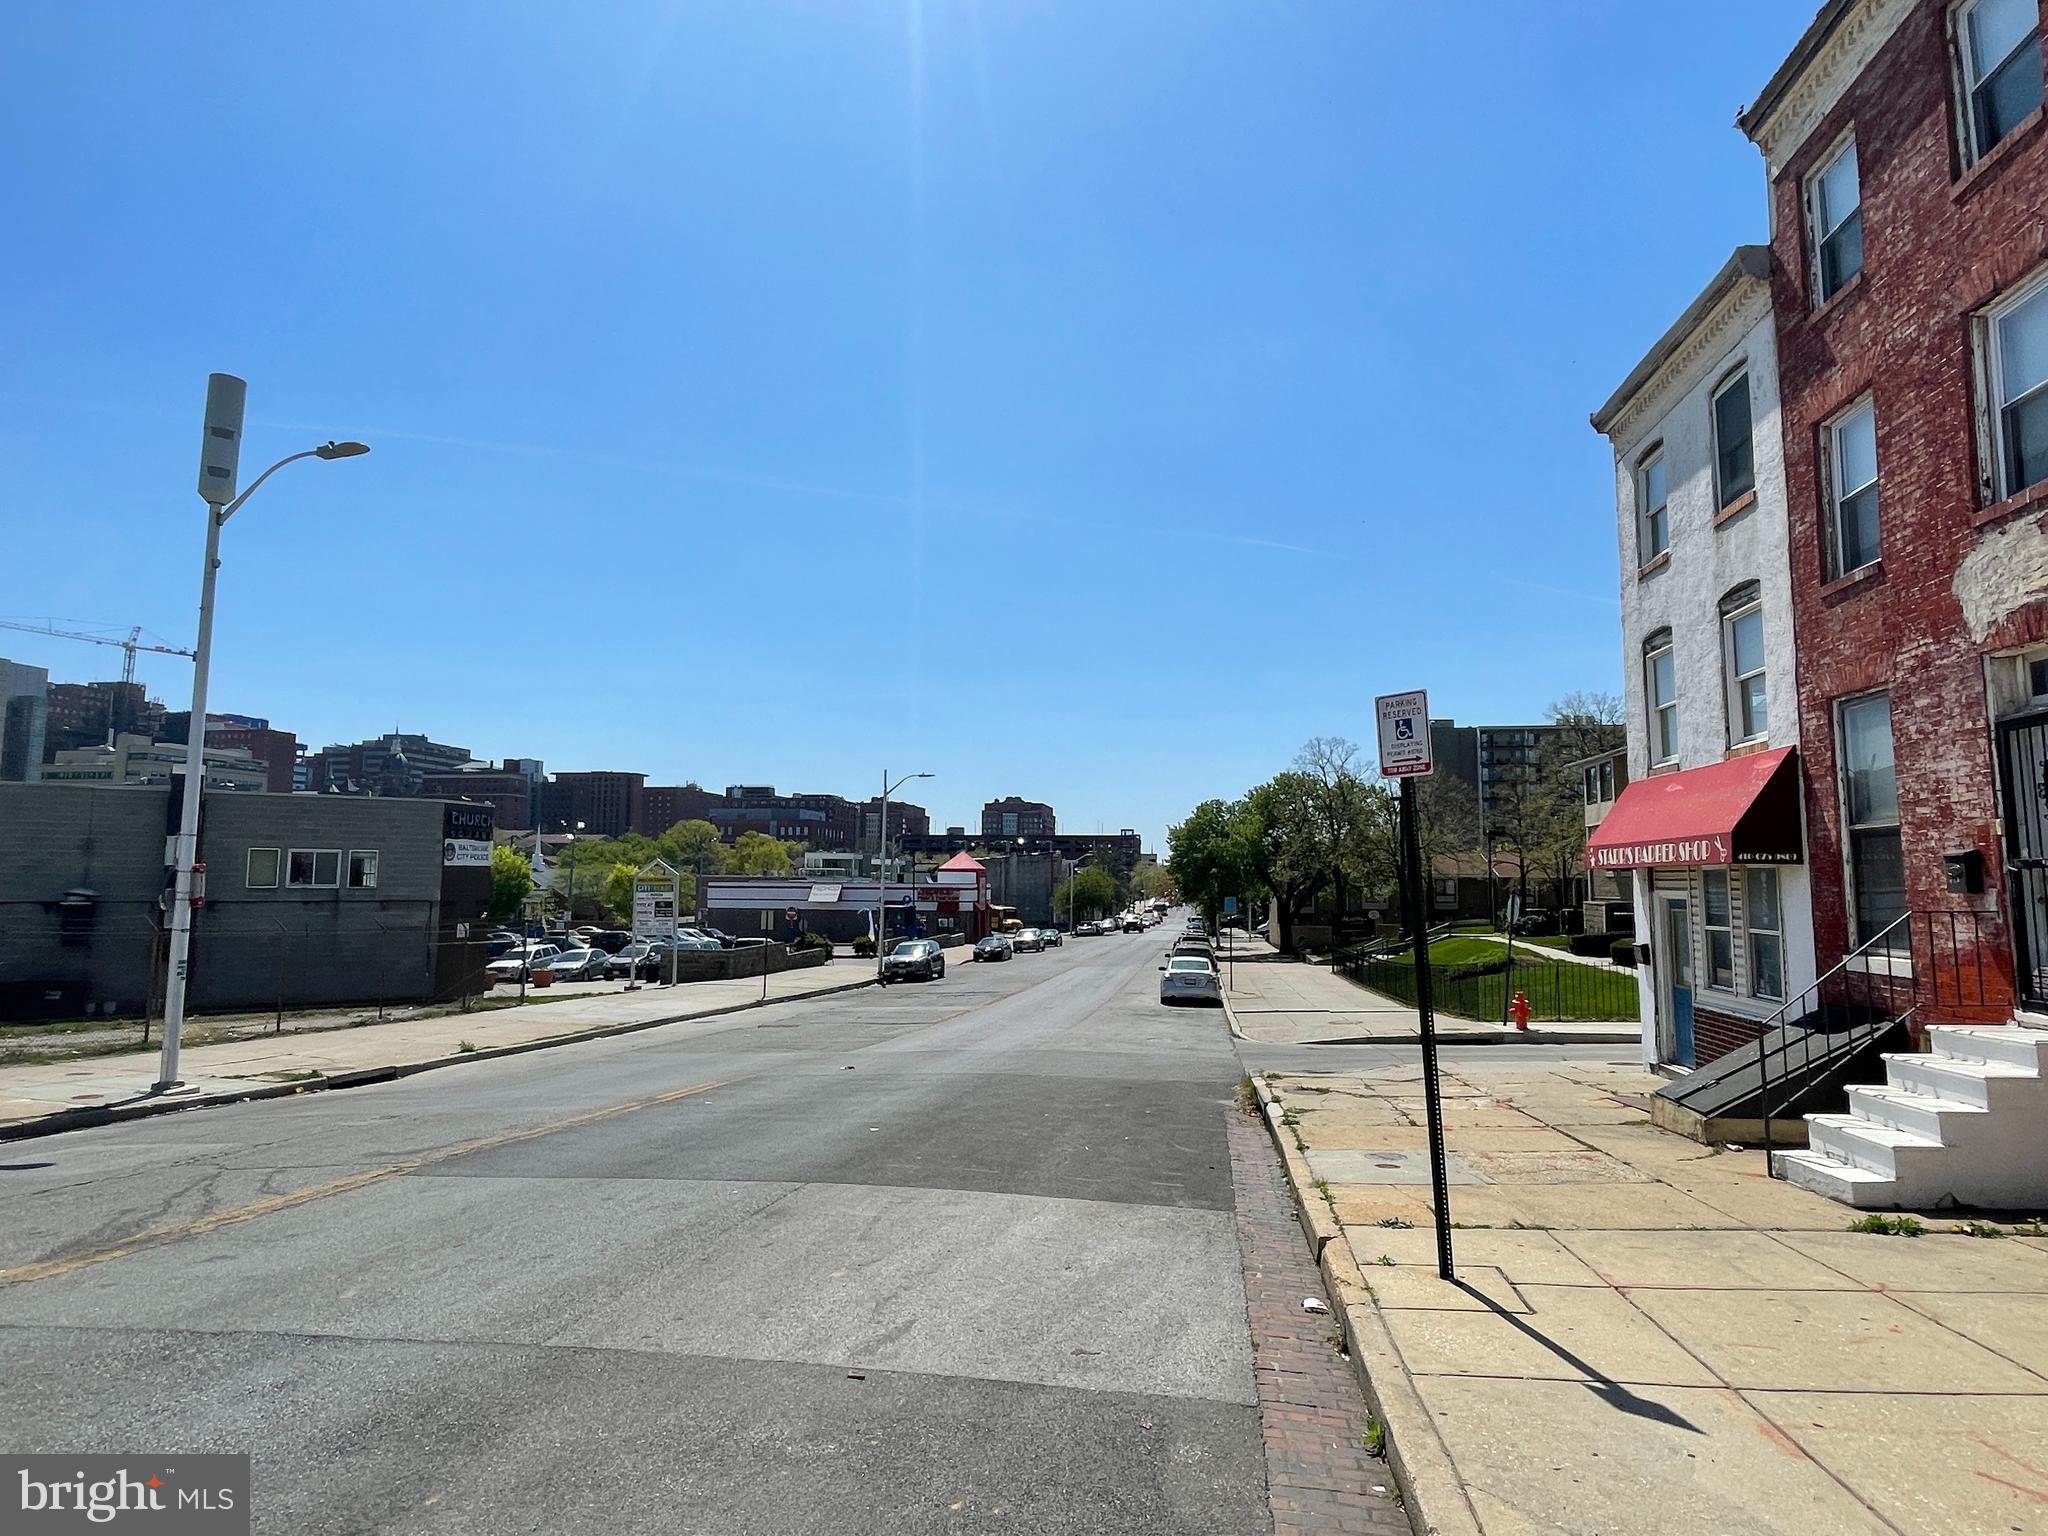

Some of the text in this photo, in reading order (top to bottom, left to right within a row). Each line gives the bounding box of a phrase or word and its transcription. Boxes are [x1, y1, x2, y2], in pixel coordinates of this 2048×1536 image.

[1385, 698, 1417, 709] PARKING
[1383, 707, 1422, 719] RESERVED
[452, 811, 493, 827] CHURCH
[1634, 842, 1677, 864] BARBER
[1678, 840, 1711, 862] SHOP
